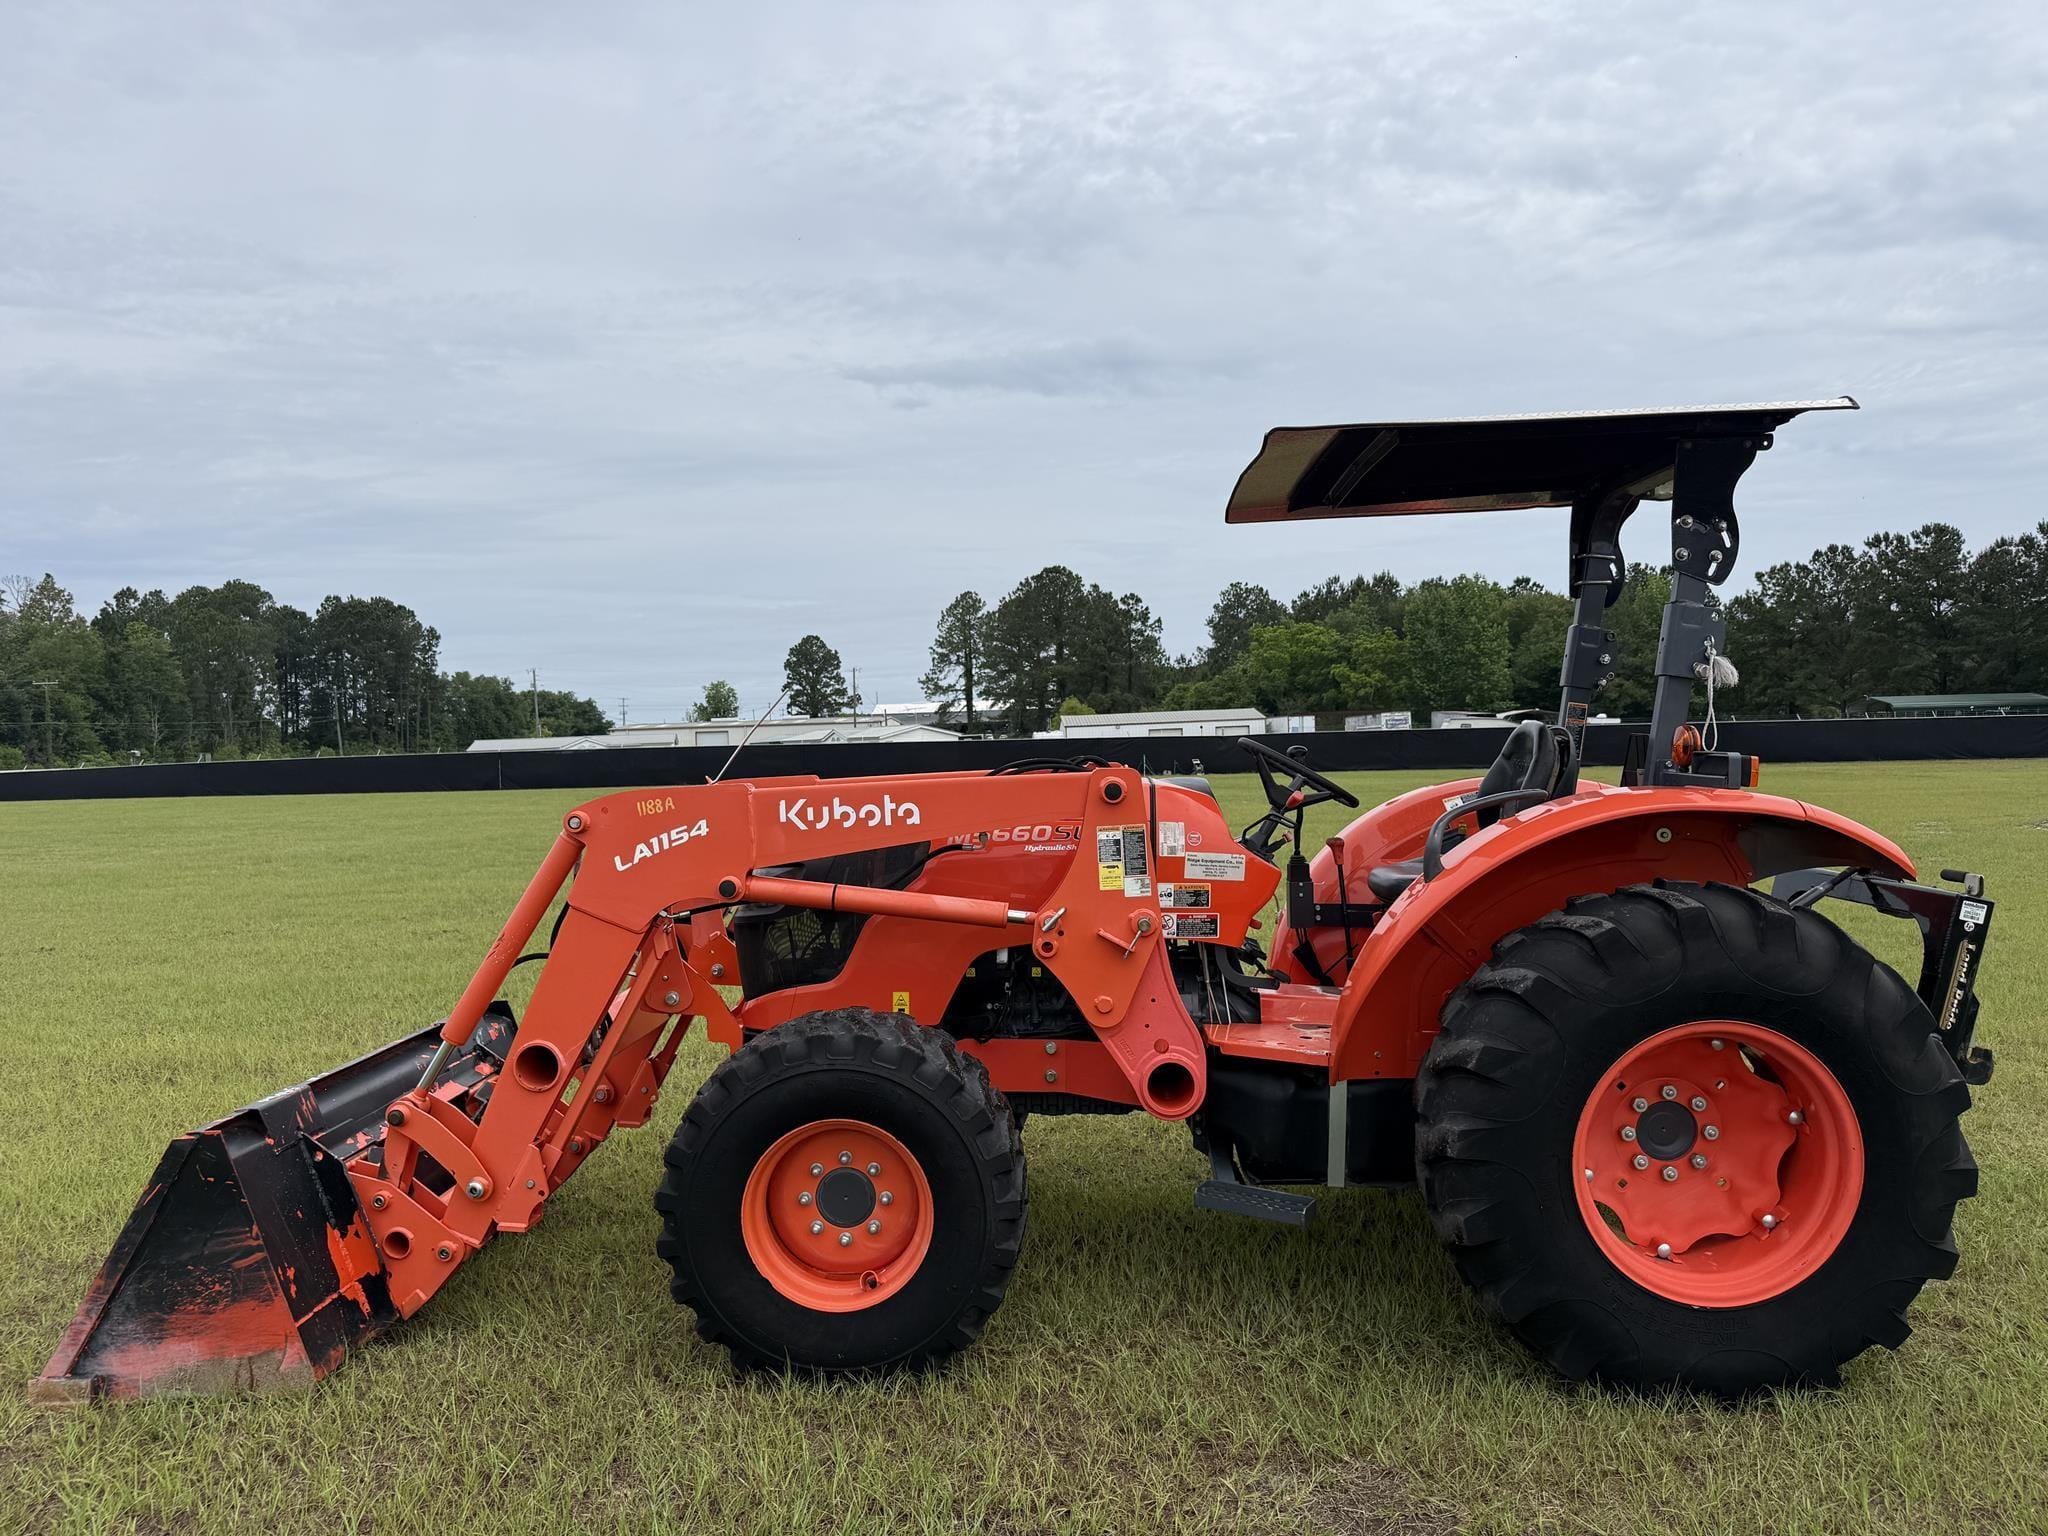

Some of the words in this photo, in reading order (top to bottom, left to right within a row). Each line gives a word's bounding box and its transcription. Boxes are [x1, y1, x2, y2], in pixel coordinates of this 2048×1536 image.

[779, 794, 921, 831] Kubota
[613, 818, 710, 873] LA1154
[1024, 844, 1066, 853] Hydraulic
[1957, 943, 1976, 983] Land
[1944, 989, 1964, 1029] Pride
